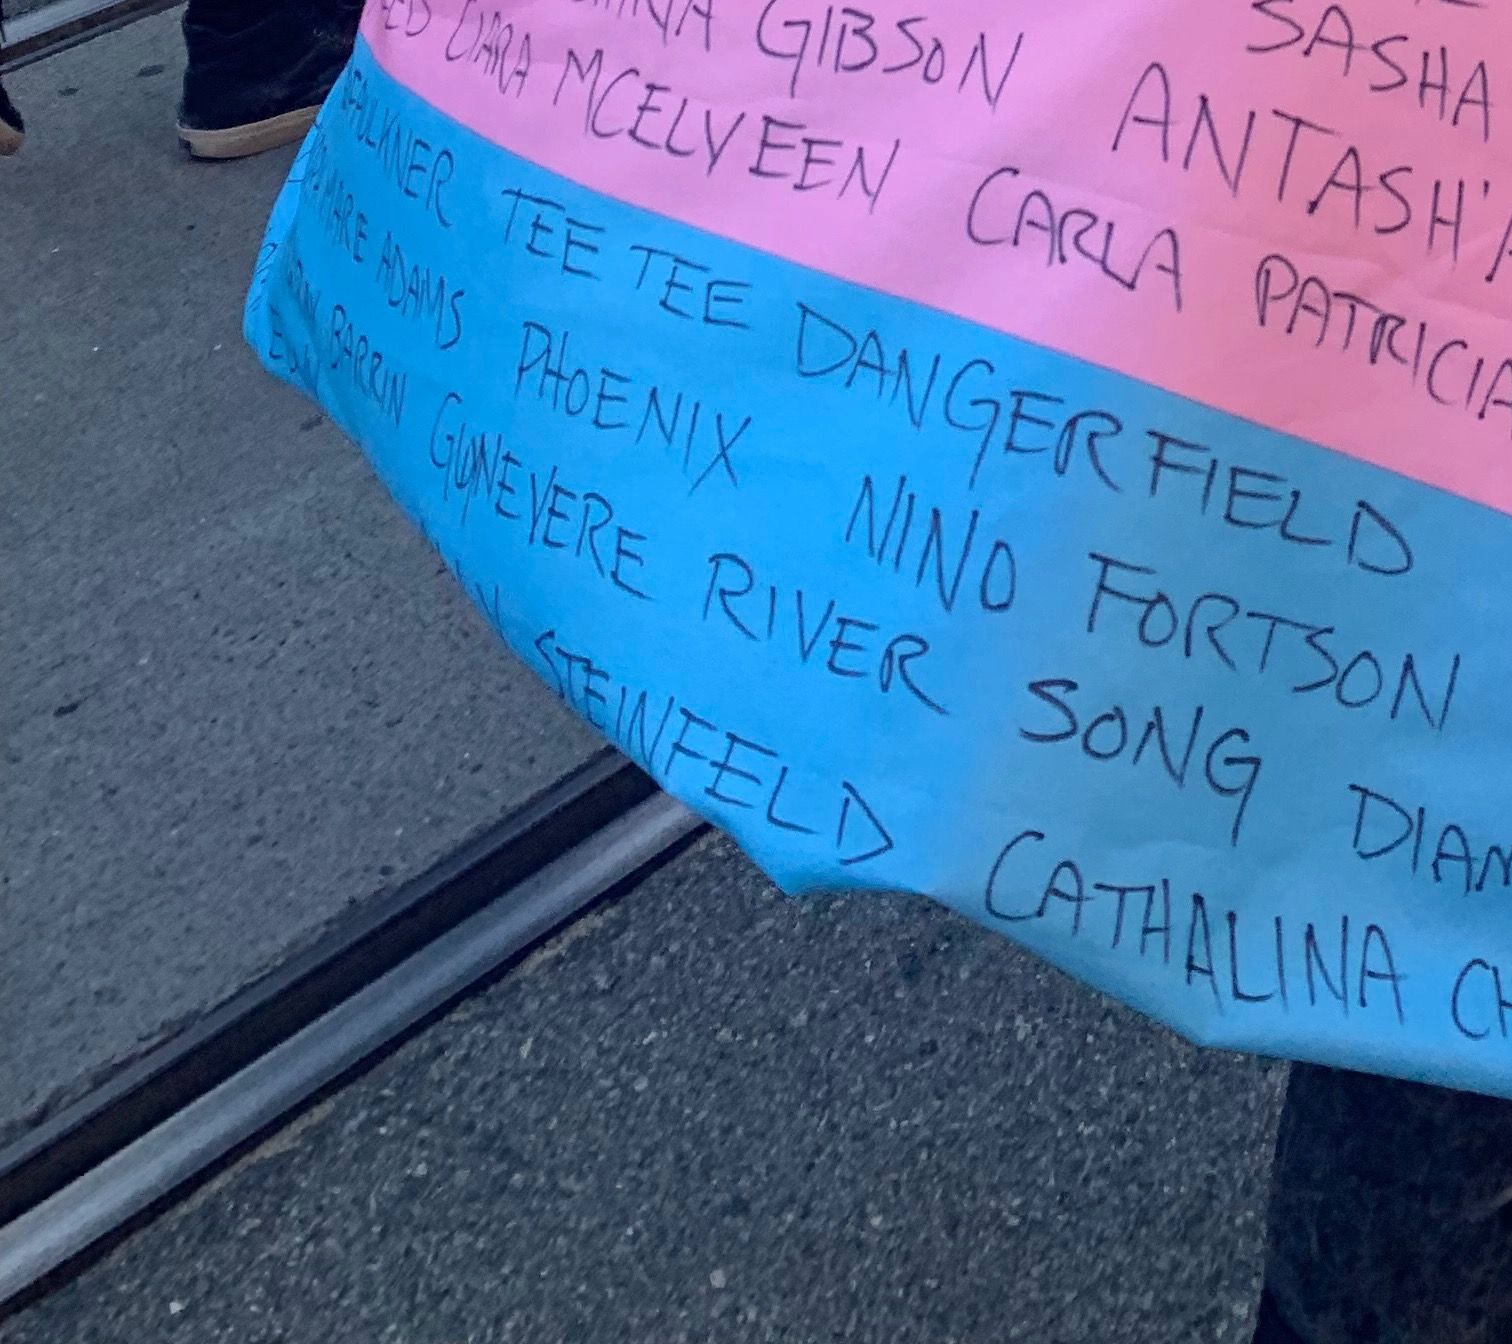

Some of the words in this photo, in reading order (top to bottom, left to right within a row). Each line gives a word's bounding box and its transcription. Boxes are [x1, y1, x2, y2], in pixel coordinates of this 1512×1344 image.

[500, 187, 606, 282] TEE
[628, 245, 751, 329] TEE
[552, 47, 901, 216] MCELVEEN
[967, 167, 1183, 314] CARLA
[514, 320, 752, 496] PHOENIX
[845, 474, 1017, 614] NINO
[1087, 552, 1461, 732] FORTSON
[701, 553, 950, 715] RIVER
[1018, 678, 1263, 847] SONG
[984, 828, 1408, 1025] CATHALINA
